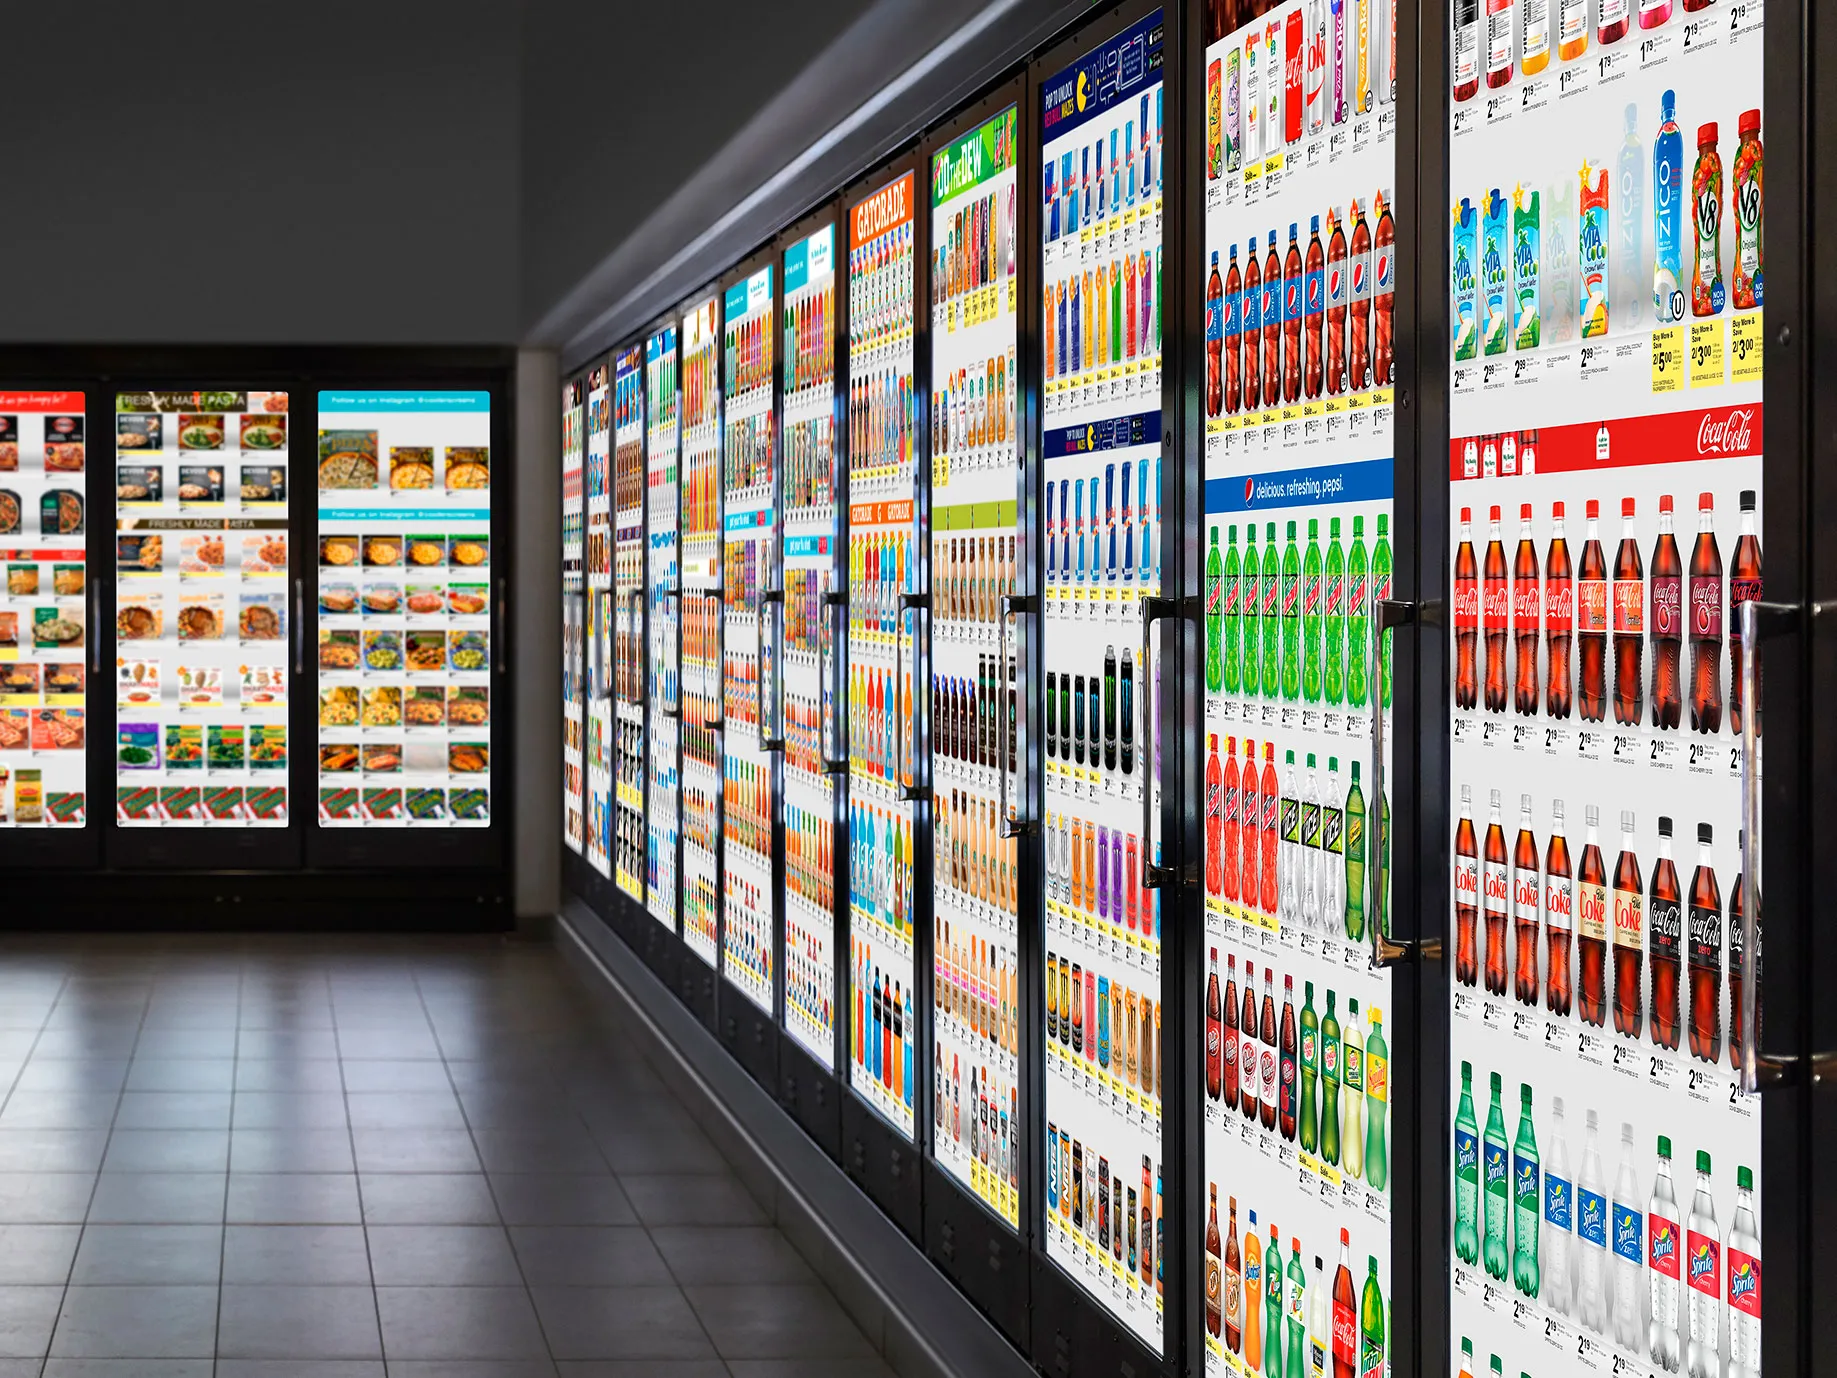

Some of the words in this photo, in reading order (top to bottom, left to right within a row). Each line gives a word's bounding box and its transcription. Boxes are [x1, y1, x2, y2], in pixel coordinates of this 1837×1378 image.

[937, 156, 949, 198] DO
[961, 134, 982, 185] DEW
[857, 180, 906, 241] GATORADE
[1659, 160, 1671, 239] ZICO
[1698, 186, 1717, 235] V8
[1739, 176, 1759, 226] V8
[1583, 226, 1601, 248] VITA
[1516, 244, 1532, 265] VITA
[1456, 259, 1470, 279] VITA
[1712, 291, 1724, 299] NON
[1712, 298, 1724, 307] GMO
[207, 395, 245, 406] PASTA
[1697, 408, 1755, 454] Coca-Cola
[1256, 478, 1286, 499] delicious.
[1286, 475, 1322, 499] refreshing.
[1322, 474, 1344, 498] pepsi.
[149, 520, 192, 528] FRESHLY
[194, 520, 220, 528] MADE
[1455, 865, 1477, 892] Coke
[1513, 878, 1538, 908] Coke
[1580, 890, 1605, 922] Coke
[1615, 898, 1641, 932] Coke
[1659, 935, 1671, 946] zero
[1697, 944, 1711, 956] zero
[1458, 1149, 1475, 1169] Sprite
[1517, 1174, 1536, 1195] Sprite
[1549, 1191, 1566, 1213] Sprite
[1618, 1224, 1635, 1244] Sprite
[1652, 1238, 1673, 1258] Sprite
[1691, 1255, 1713, 1278] Sprite
[1731, 1273, 1755, 1295] Sprite
